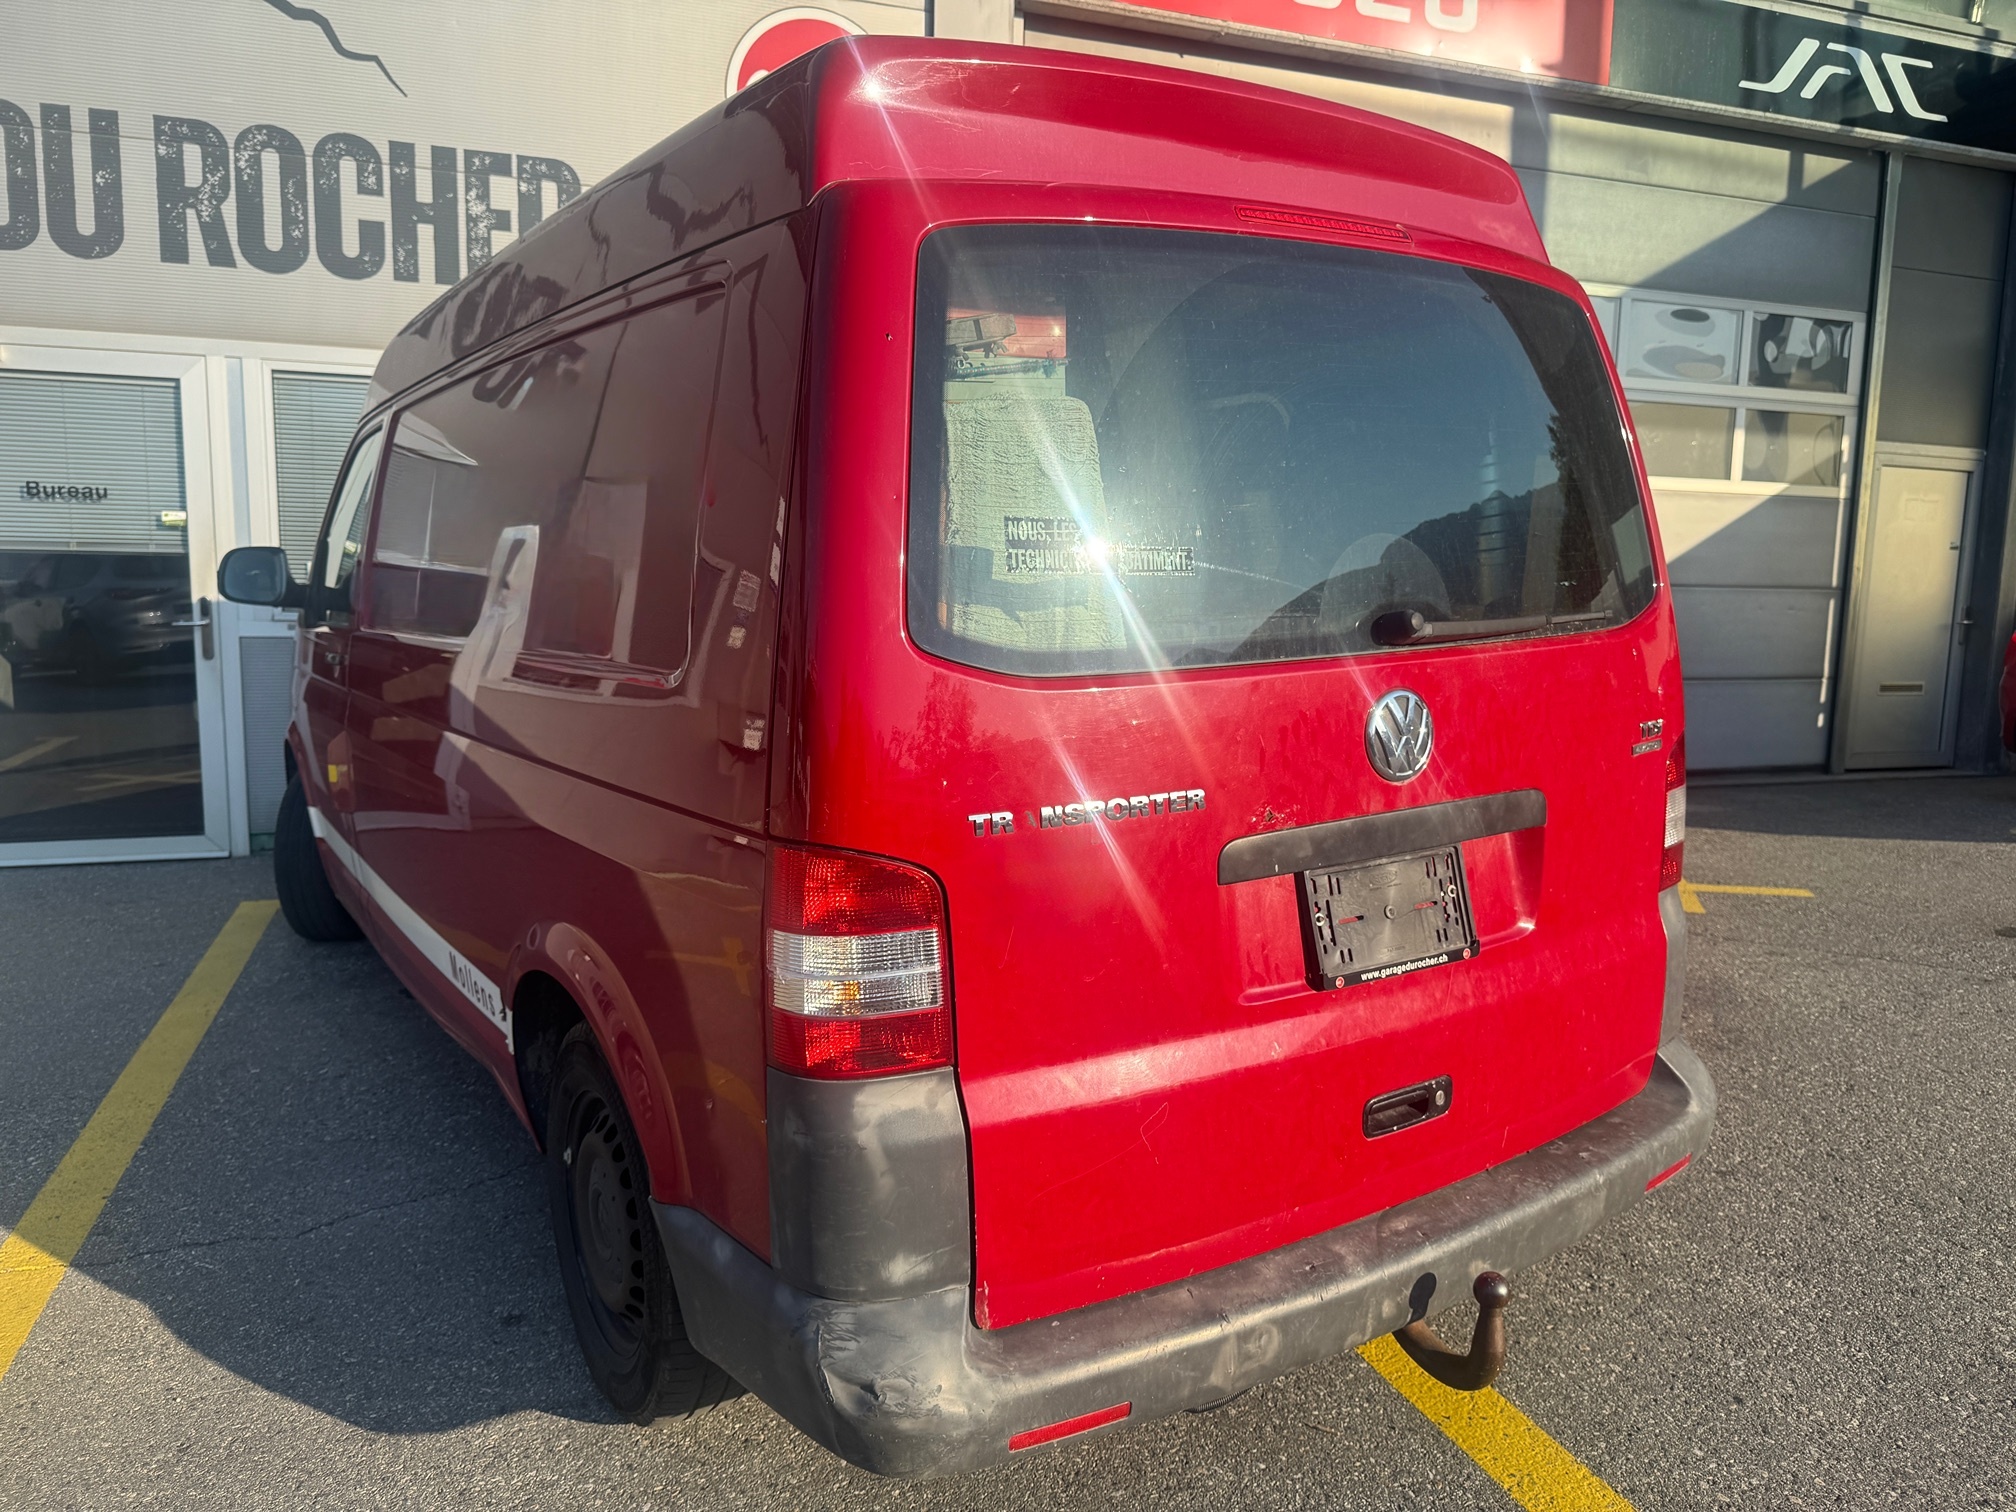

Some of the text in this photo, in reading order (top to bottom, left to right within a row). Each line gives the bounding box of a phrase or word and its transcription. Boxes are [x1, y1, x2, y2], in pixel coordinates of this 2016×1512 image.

[1738, 37, 1949, 123] JAC
[25, 481, 108, 499] Bureau
[967, 788, 1206, 837] TRNSPORTER
[448, 951, 496, 1017] Mollens
[1360, 953, 1448, 981] www.garagedurocher.ch
